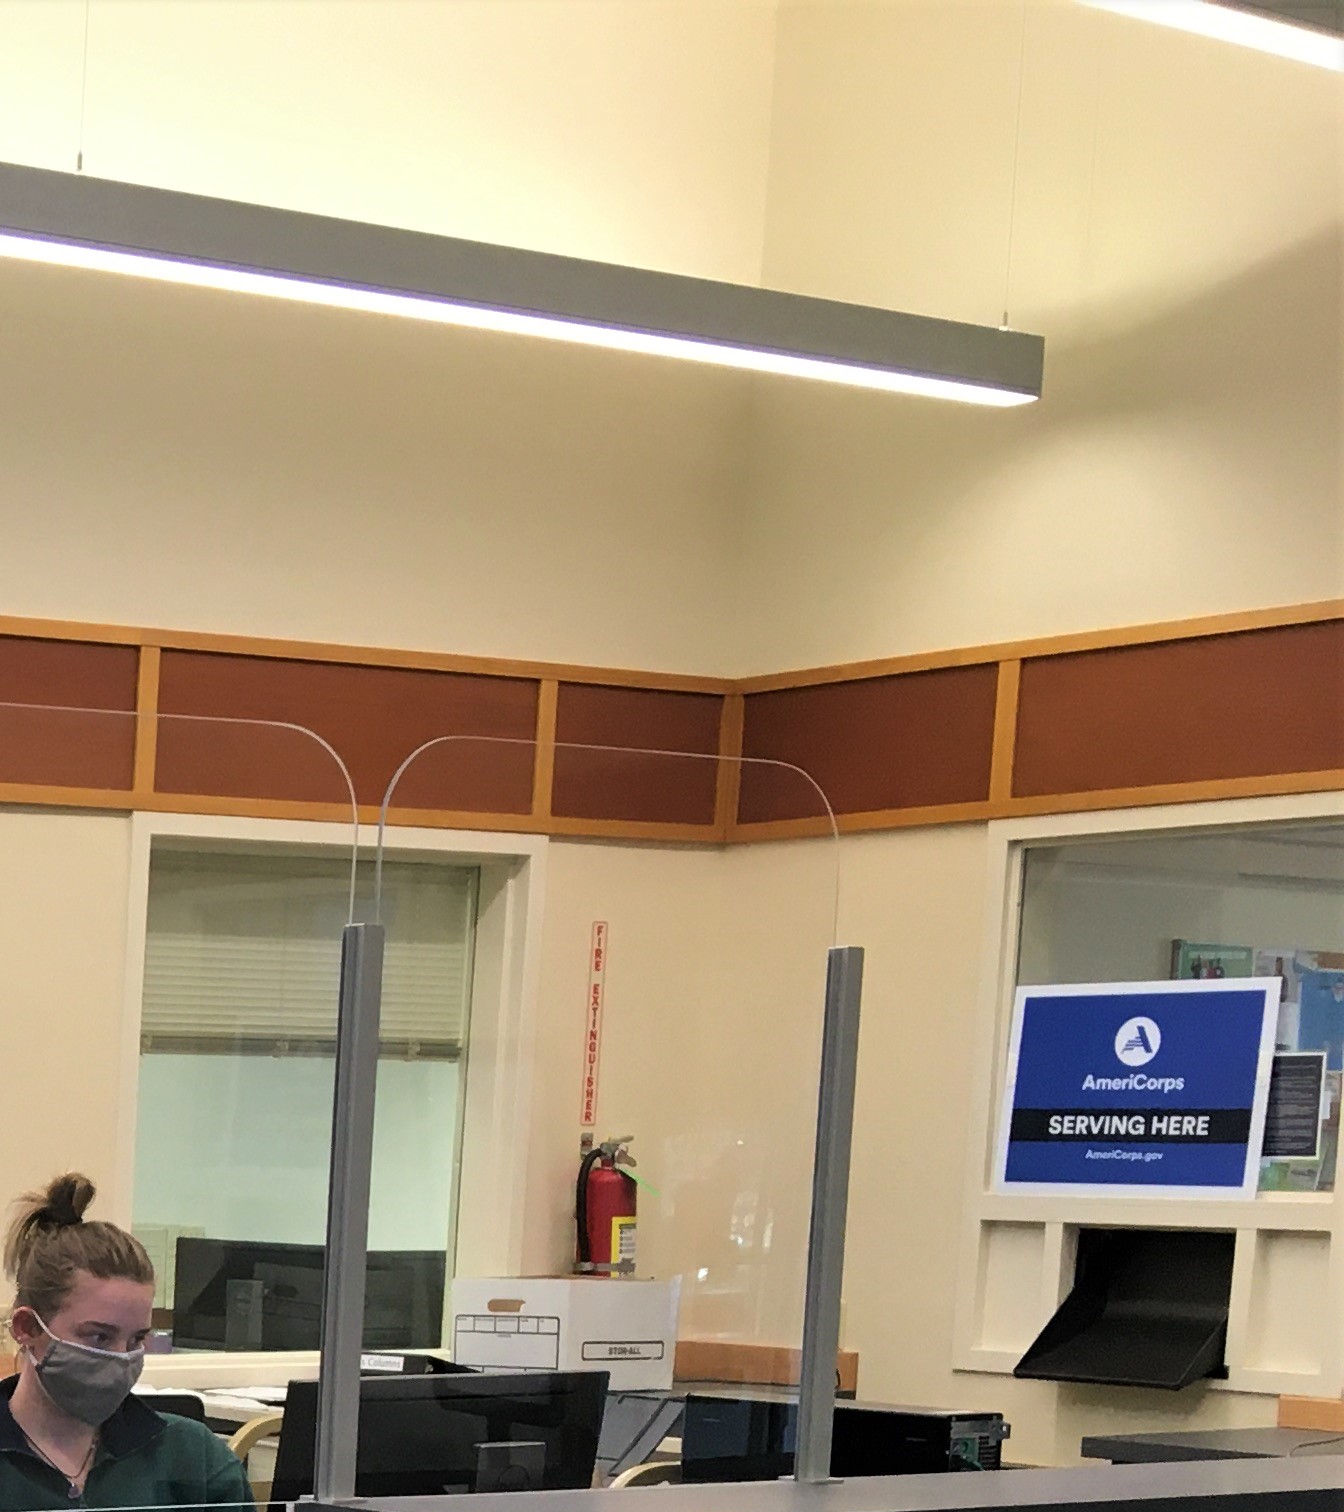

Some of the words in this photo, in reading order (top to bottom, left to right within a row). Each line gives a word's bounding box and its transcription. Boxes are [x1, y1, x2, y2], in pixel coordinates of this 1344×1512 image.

[594, 925, 604, 972] FIRE
[584, 983, 600, 1122] EXTINGUISHER
[1081, 1073, 1185, 1094] AmeriCorps
[1048, 1114, 1146, 1136] SERVING
[1151, 1115, 1210, 1136] HERE
[1085, 1149, 1163, 1162] AmeriCorps.gov
